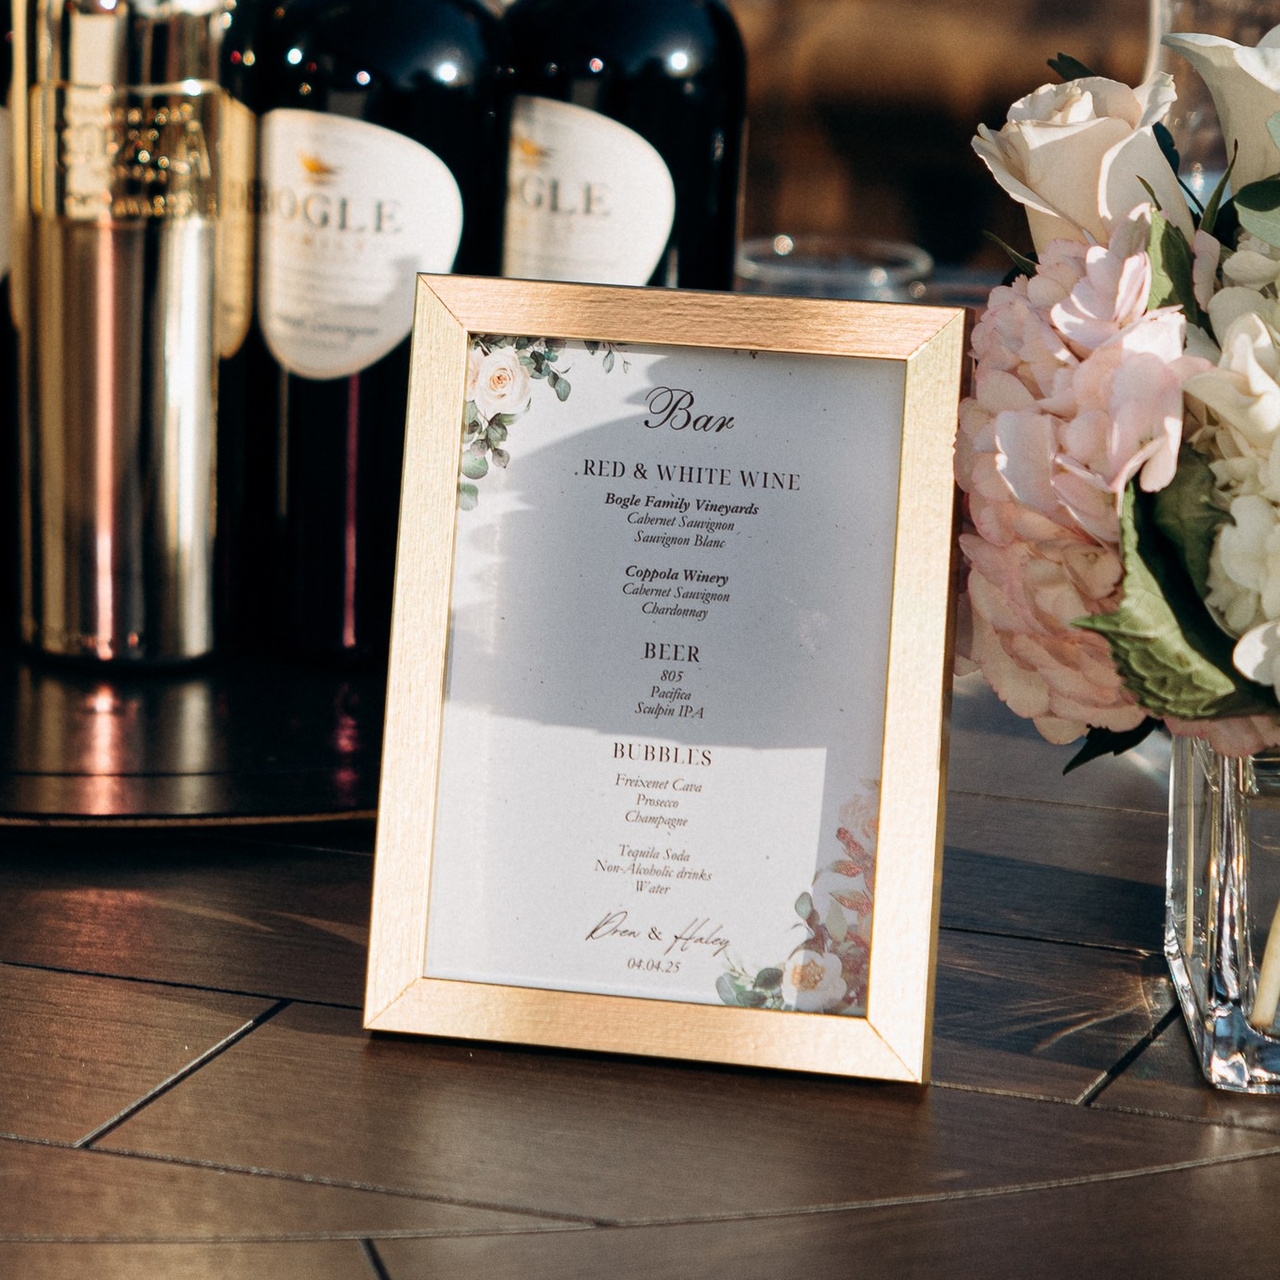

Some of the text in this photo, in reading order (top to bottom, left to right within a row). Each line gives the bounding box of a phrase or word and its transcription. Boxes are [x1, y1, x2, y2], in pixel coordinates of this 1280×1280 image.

[644, 386, 735, 434] Bar
[583, 459, 801, 491] RED & WHITE WINE
[605, 493, 760, 517] Bogle Family Vineyards
[627, 512, 735, 533] Cabernet Sauvignon
[634, 531, 727, 550] Sauvignon Blanc
[625, 565, 730, 588] Coppola Winery
[622, 583, 731, 605] Cabernet Sauvignon
[642, 601, 709, 622] Chardonnay
[644, 642, 701, 663] BEER
[661, 670, 684, 683] 805
[635, 702, 675, 720] Sculpin
[613, 742, 713, 767] BUBBLES
[615, 773, 703, 794] Freixenet Cava
[636, 794, 679, 809] Prosecco
[625, 810, 689, 829] Champagne
[619, 845, 691, 863] Tequila Soda
[595, 860, 713, 882] Non-Alcoholic drinks
[636, 881, 672, 895] Water
[648, 927, 663, 942] &
[664, 918, 731, 957] Haley
[627, 958, 682, 974] 04.04.25
